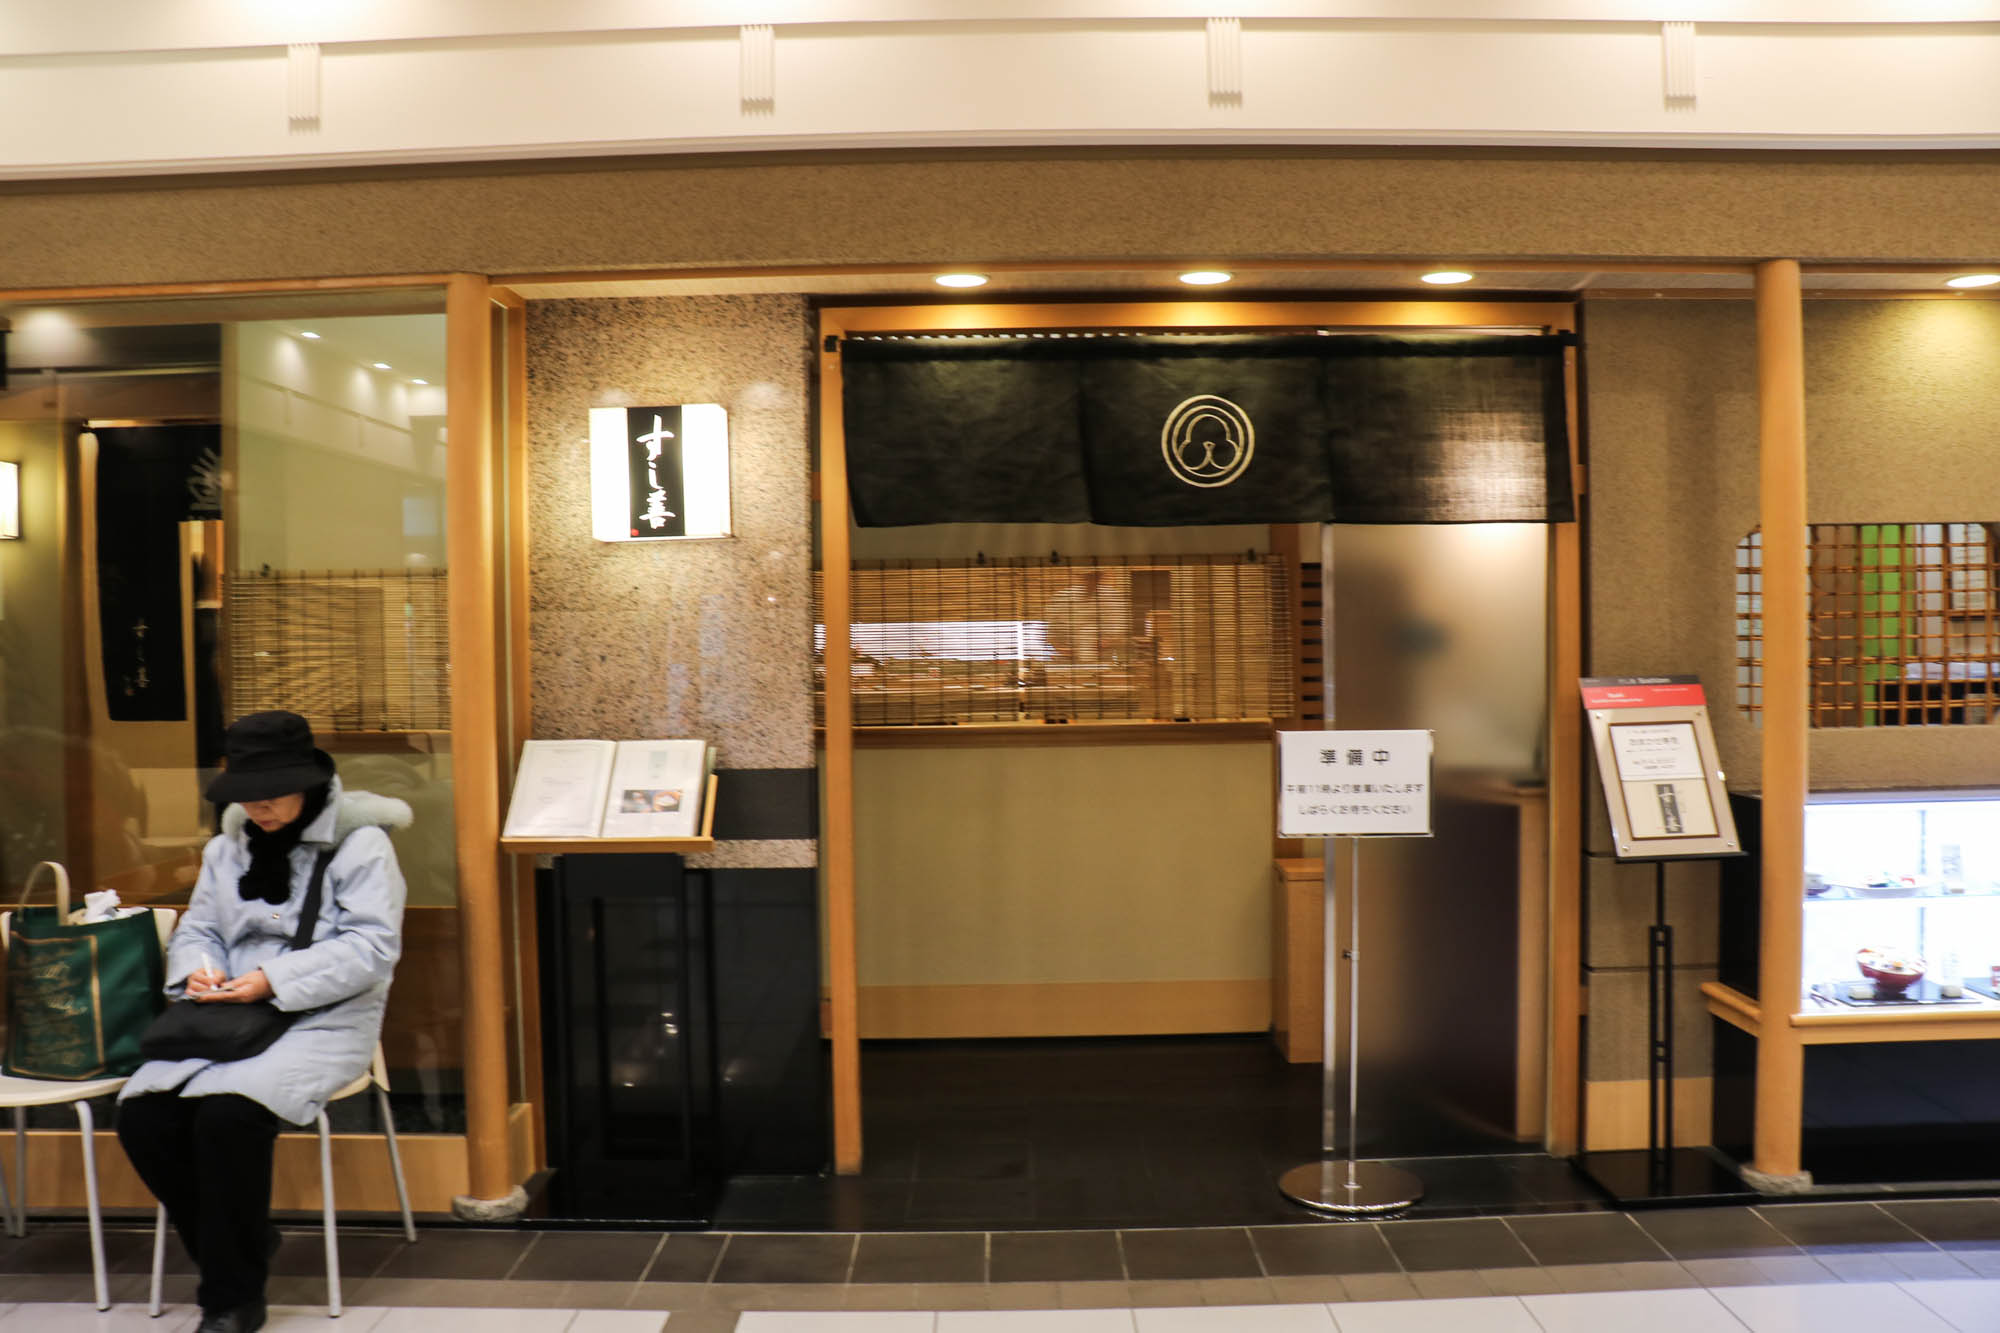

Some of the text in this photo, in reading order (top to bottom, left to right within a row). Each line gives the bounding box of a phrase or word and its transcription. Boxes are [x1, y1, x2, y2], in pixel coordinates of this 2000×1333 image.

[635, 414, 677, 530] すし善
[1320, 748, 1391, 766] 準備中
[1298, 804, 1412, 816] しばらくお待ちください
